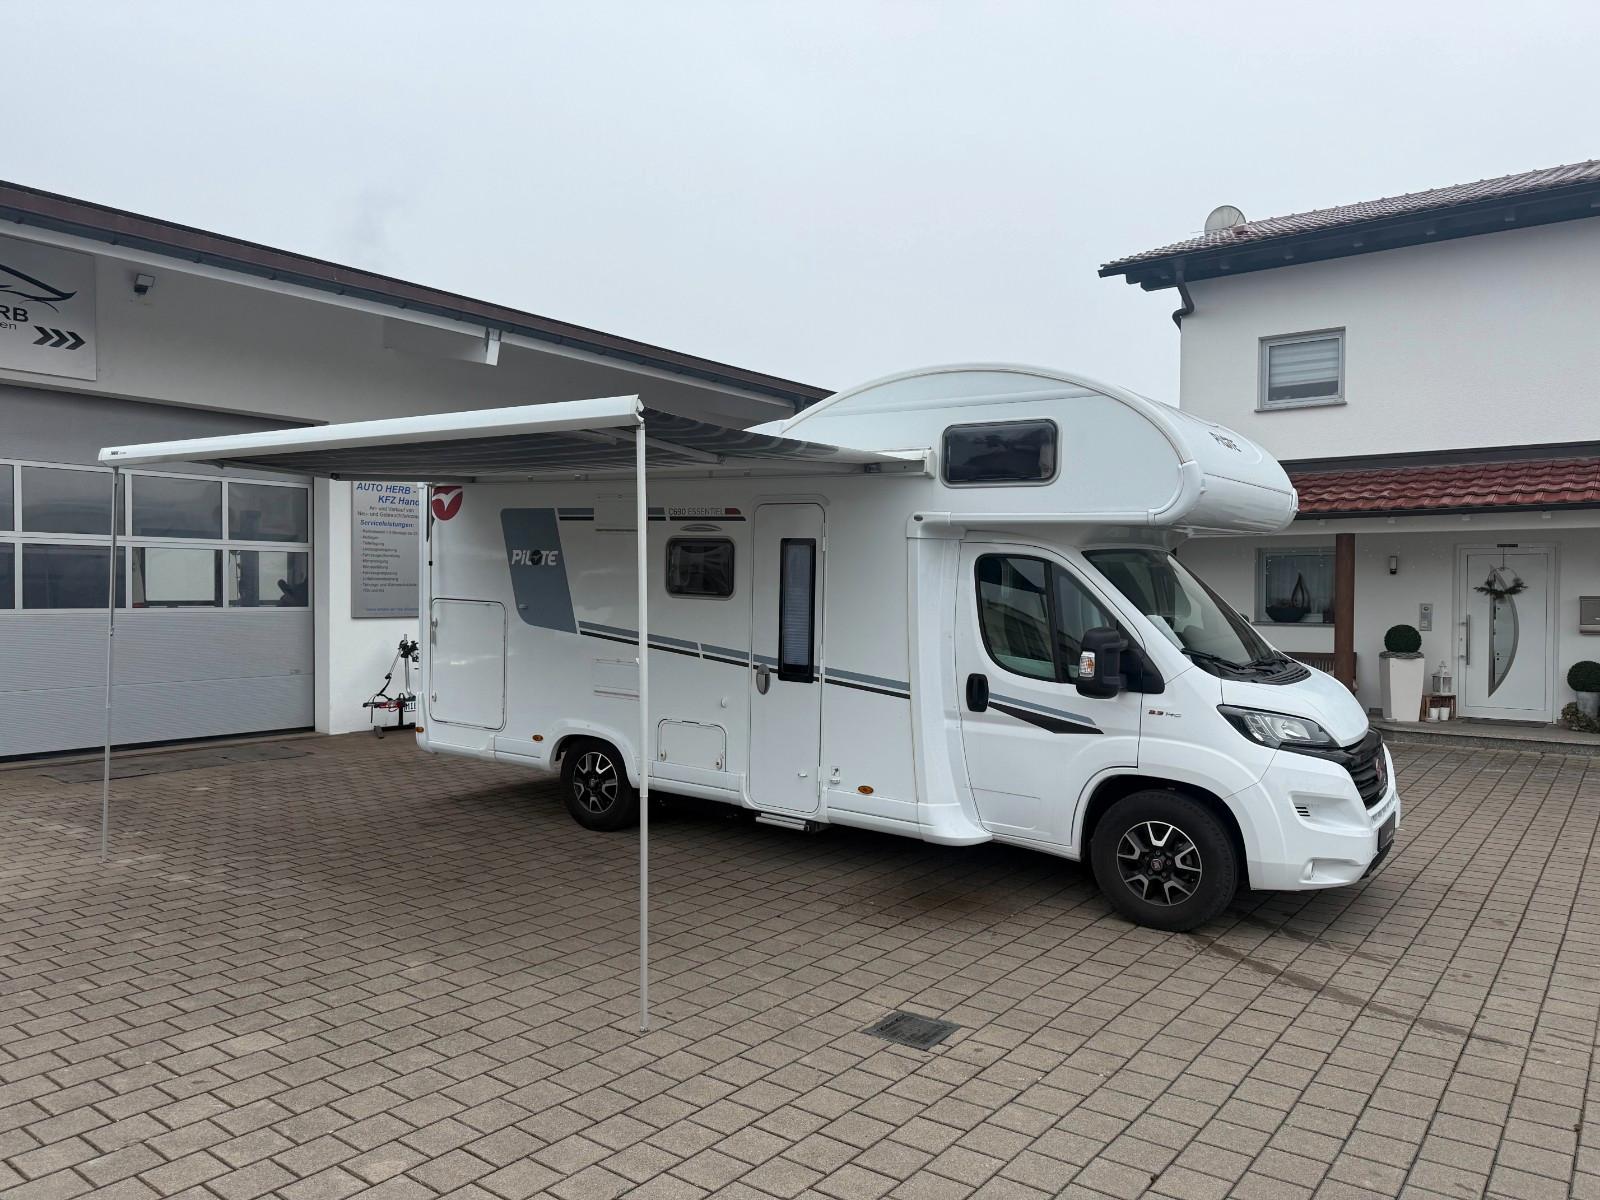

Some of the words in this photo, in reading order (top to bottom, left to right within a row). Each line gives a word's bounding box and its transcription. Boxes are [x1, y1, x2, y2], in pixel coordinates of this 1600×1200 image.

[356, 482, 383, 492] AUTO
[385, 485, 411, 495] HERB
[378, 495, 397, 505] KFZ
